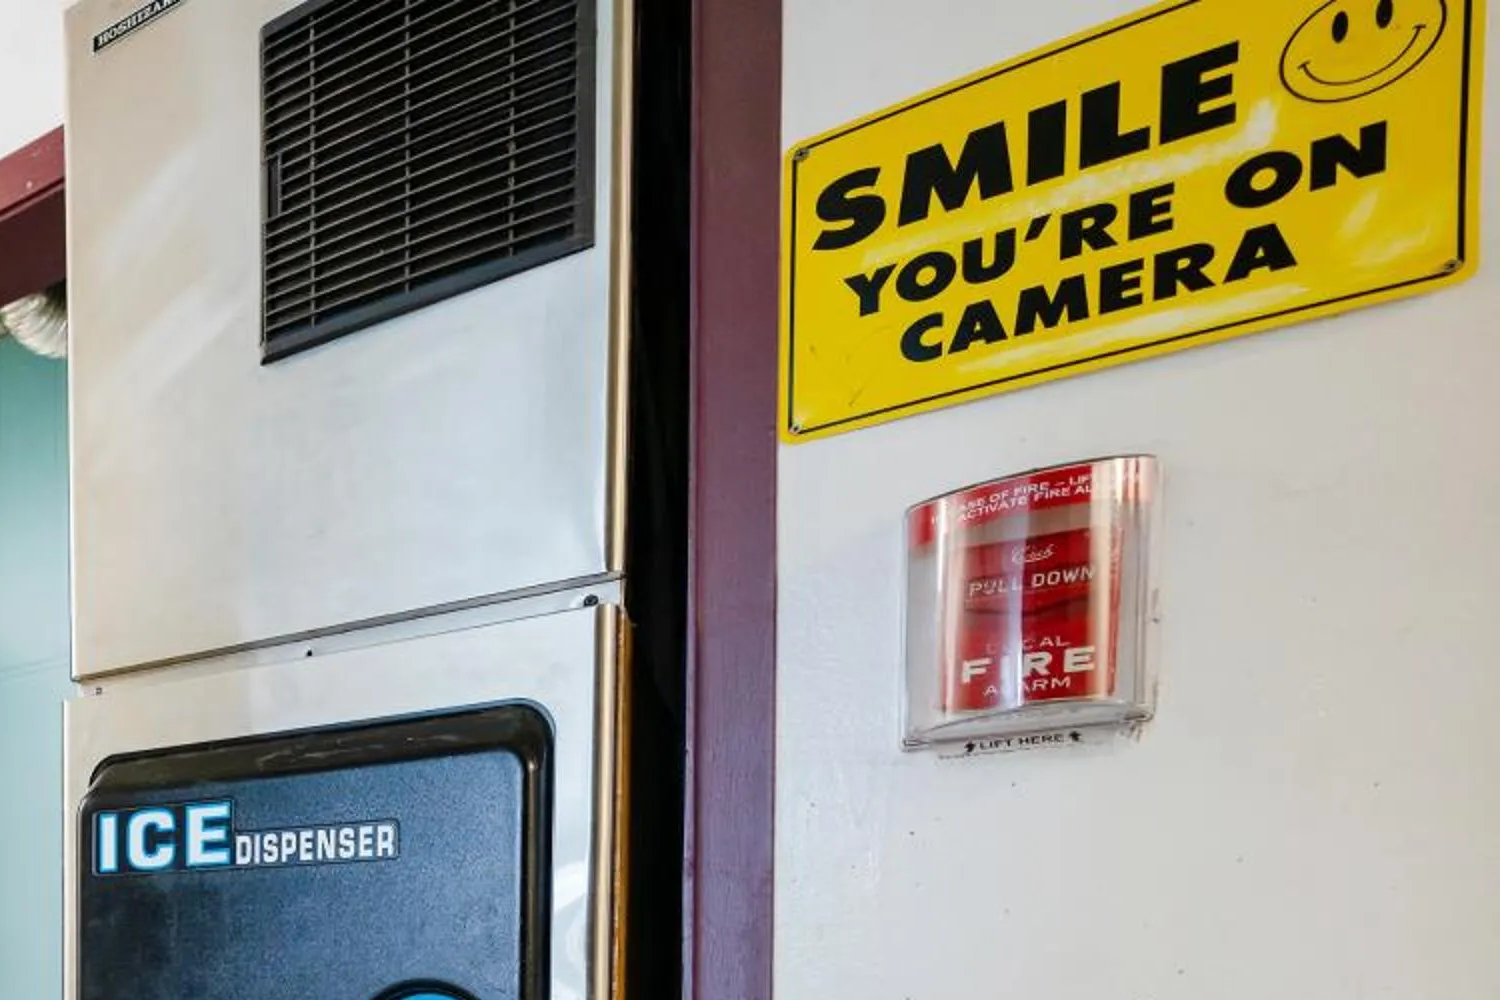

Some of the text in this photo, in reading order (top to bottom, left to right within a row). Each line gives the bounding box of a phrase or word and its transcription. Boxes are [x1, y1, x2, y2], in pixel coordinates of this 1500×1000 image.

[812, 40, 1240, 251] SMILE
[843, 120, 1387, 317] YOU'RE ON
[899, 222, 1297, 363] CAMERA
[989, 488, 1010, 503] OF
[1013, 481, 1049, 496] FIRE
[1069, 474, 1092, 486] LIF
[1033, 487, 1071, 502] FIRE
[968, 565, 1096, 598] PULL DOWN
[983, 676, 1072, 696] ARM
[979, 734, 1065, 751] LIFT HERE
[99, 800, 396, 873] ICE DISPENSER
